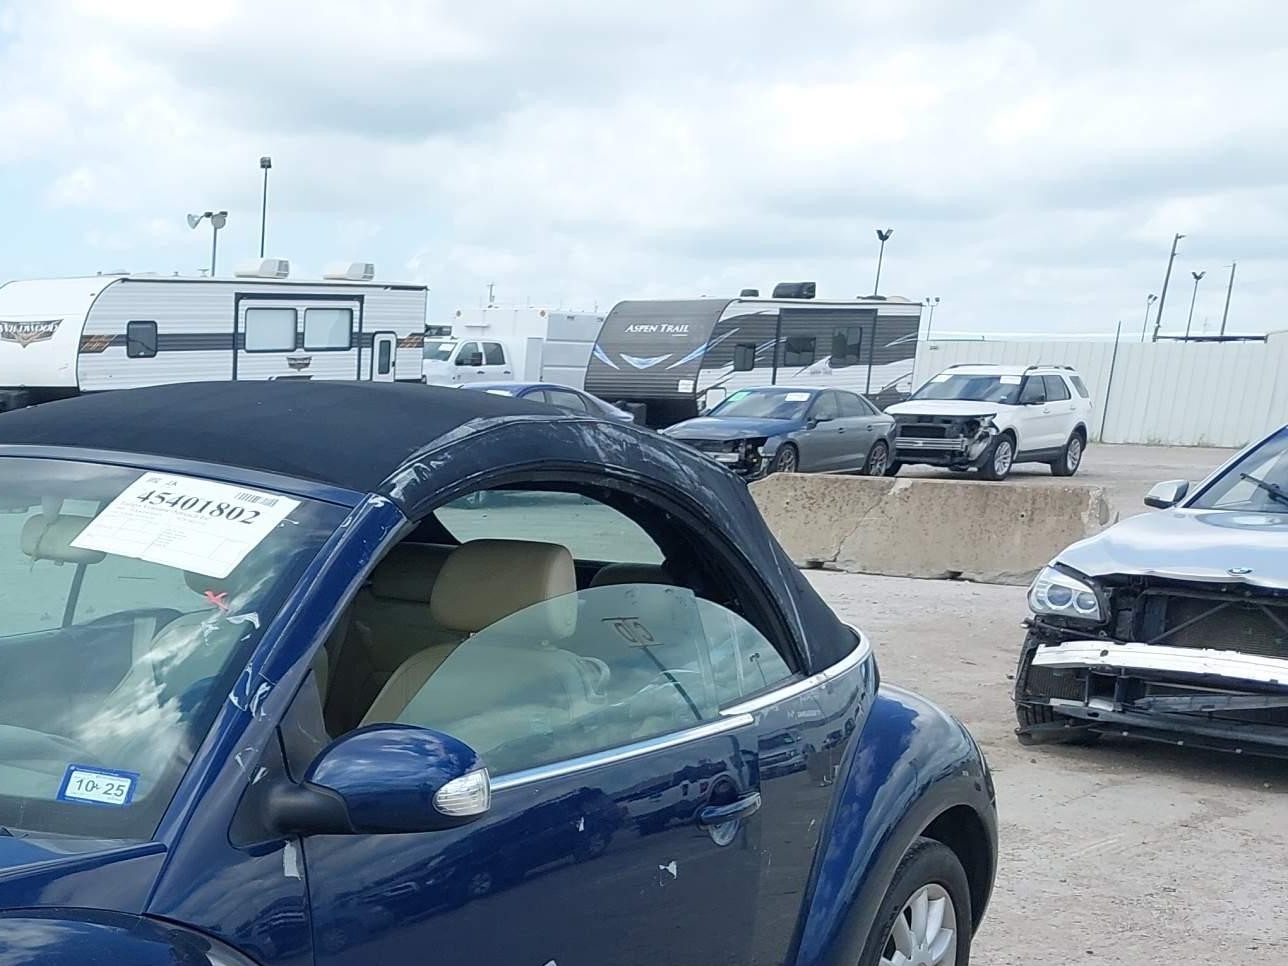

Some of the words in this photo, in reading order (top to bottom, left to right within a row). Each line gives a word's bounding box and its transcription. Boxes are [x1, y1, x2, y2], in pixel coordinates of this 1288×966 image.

[625, 324, 658, 333] ASPEN
[659, 323, 689, 333] TRAIL
[137, 489, 261, 525] 45401802
[75, 779, 96, 793] 10
[102, 783, 126, 797] 25
